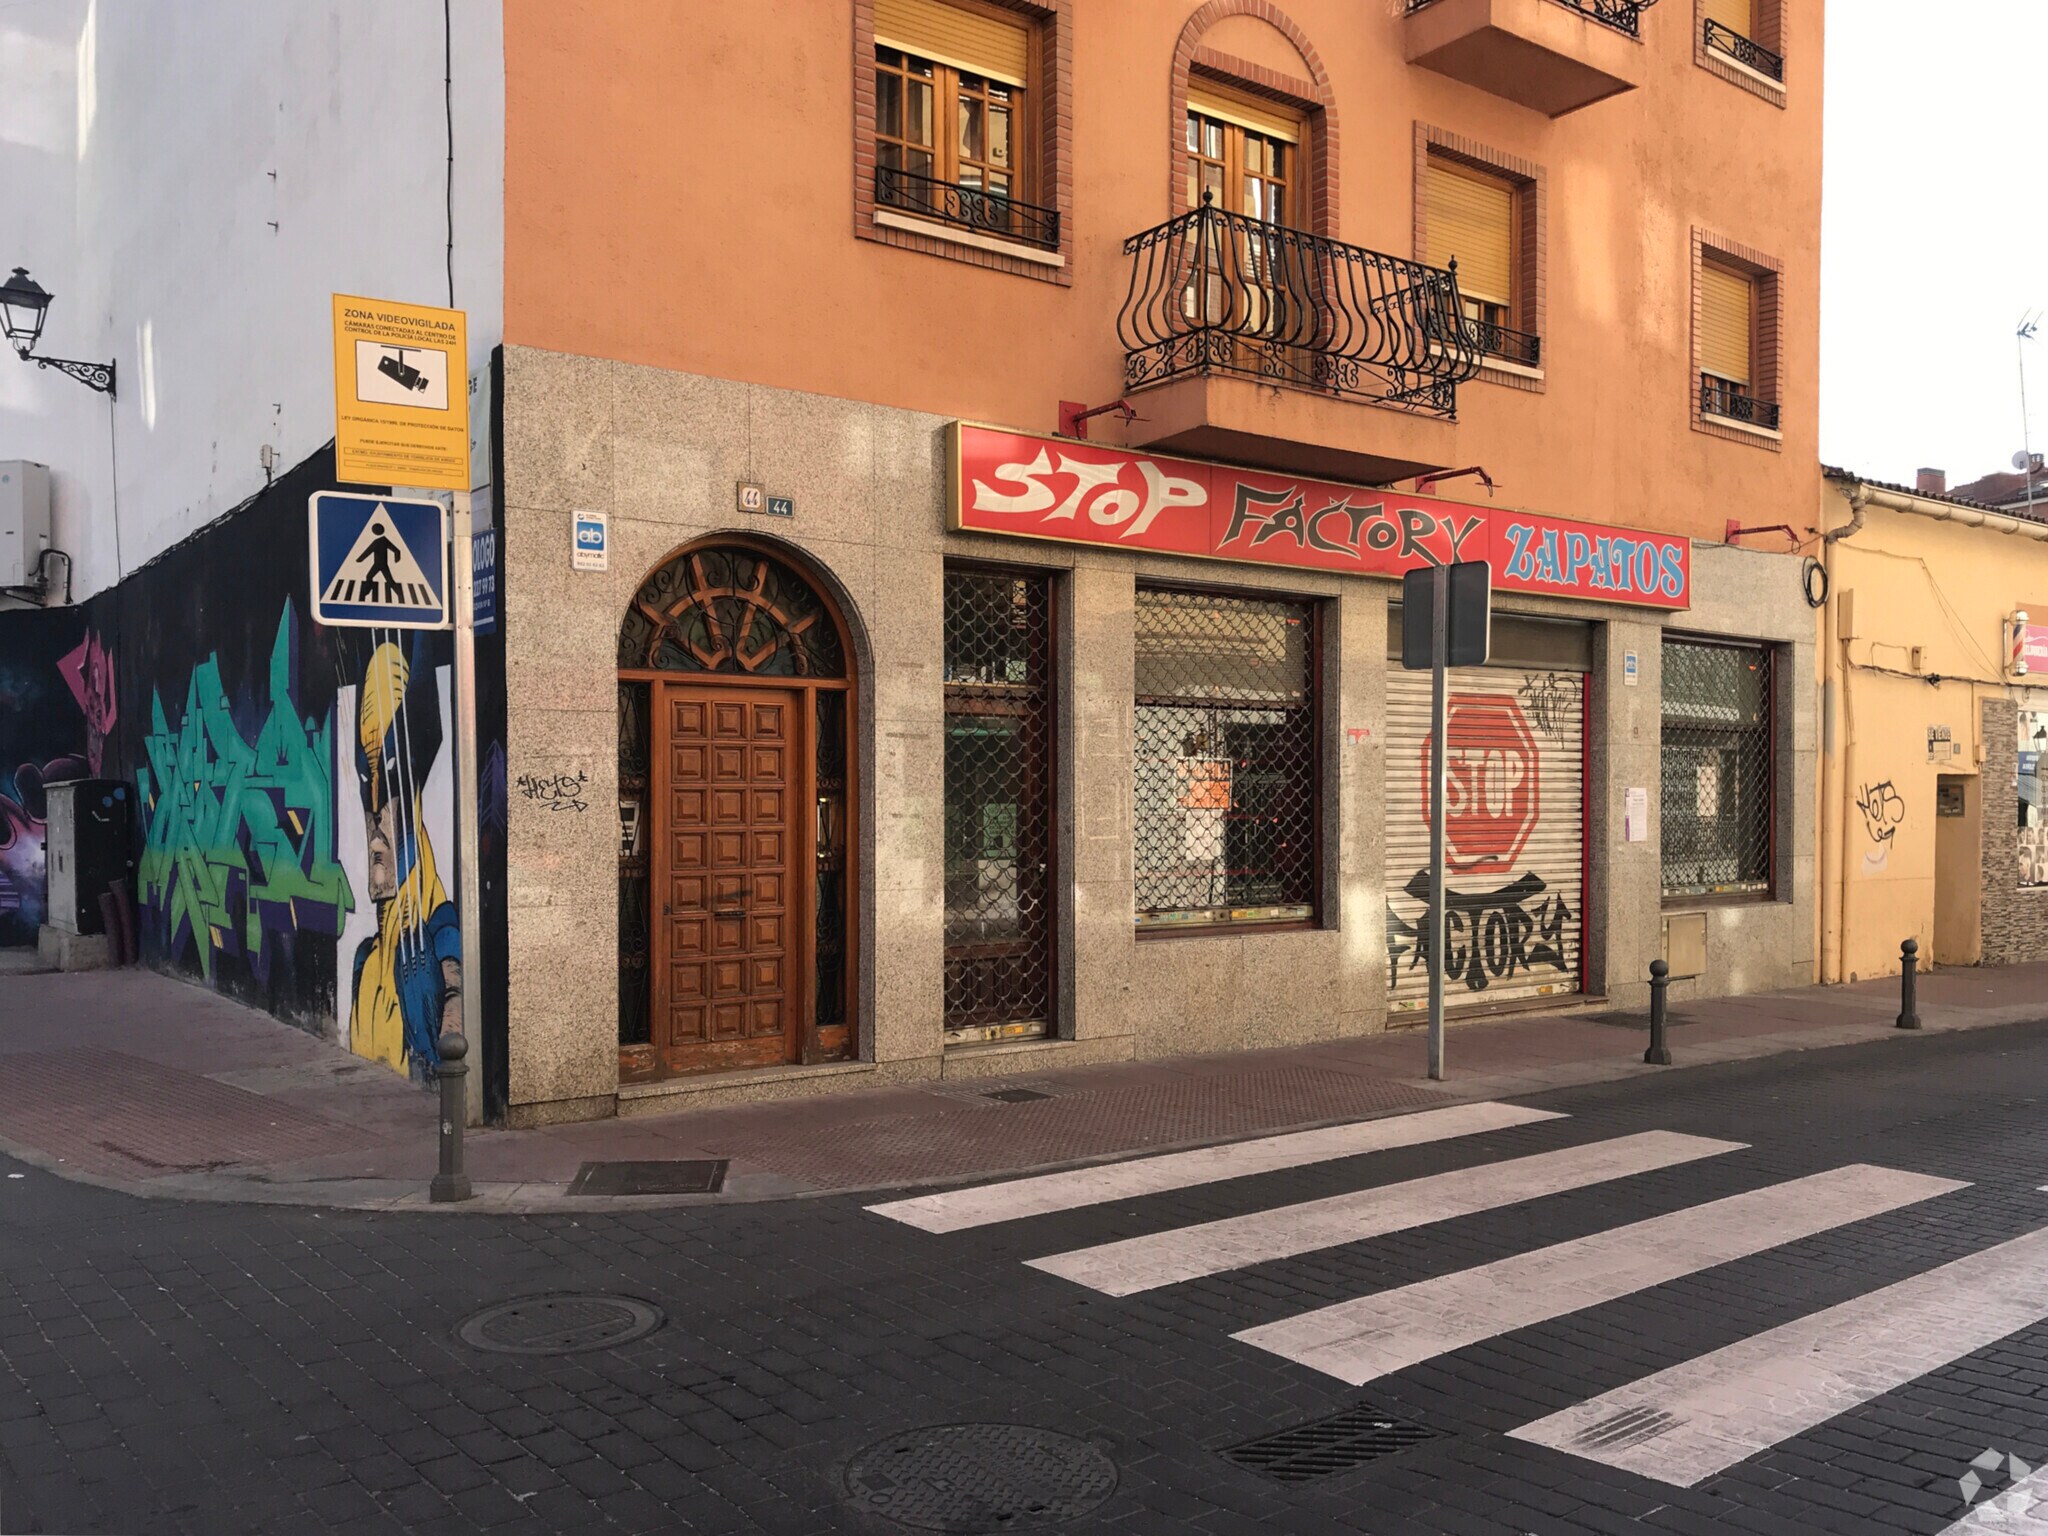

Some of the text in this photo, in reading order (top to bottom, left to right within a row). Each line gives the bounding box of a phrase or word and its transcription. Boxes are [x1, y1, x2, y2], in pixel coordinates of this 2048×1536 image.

[344, 308, 456, 332] ZONA VIDEOVIGILADA
[344, 319, 375, 330] CÁMARAS
[375, 324, 415, 335] CONECTADAS
[424, 330, 448, 340] CENTRO
[344, 326, 373, 336] CONTROL
[414, 335, 433, 343] LOCAL
[745, 490, 759, 506] 44
[773, 500, 788, 515] 44
[971, 445, 1684, 599] STOP FACTORY ZAPATOS
[579, 527, 603, 545] ab
[1446, 749, 1524, 819] STOP
[1386, 891, 1573, 992] FACTORY
